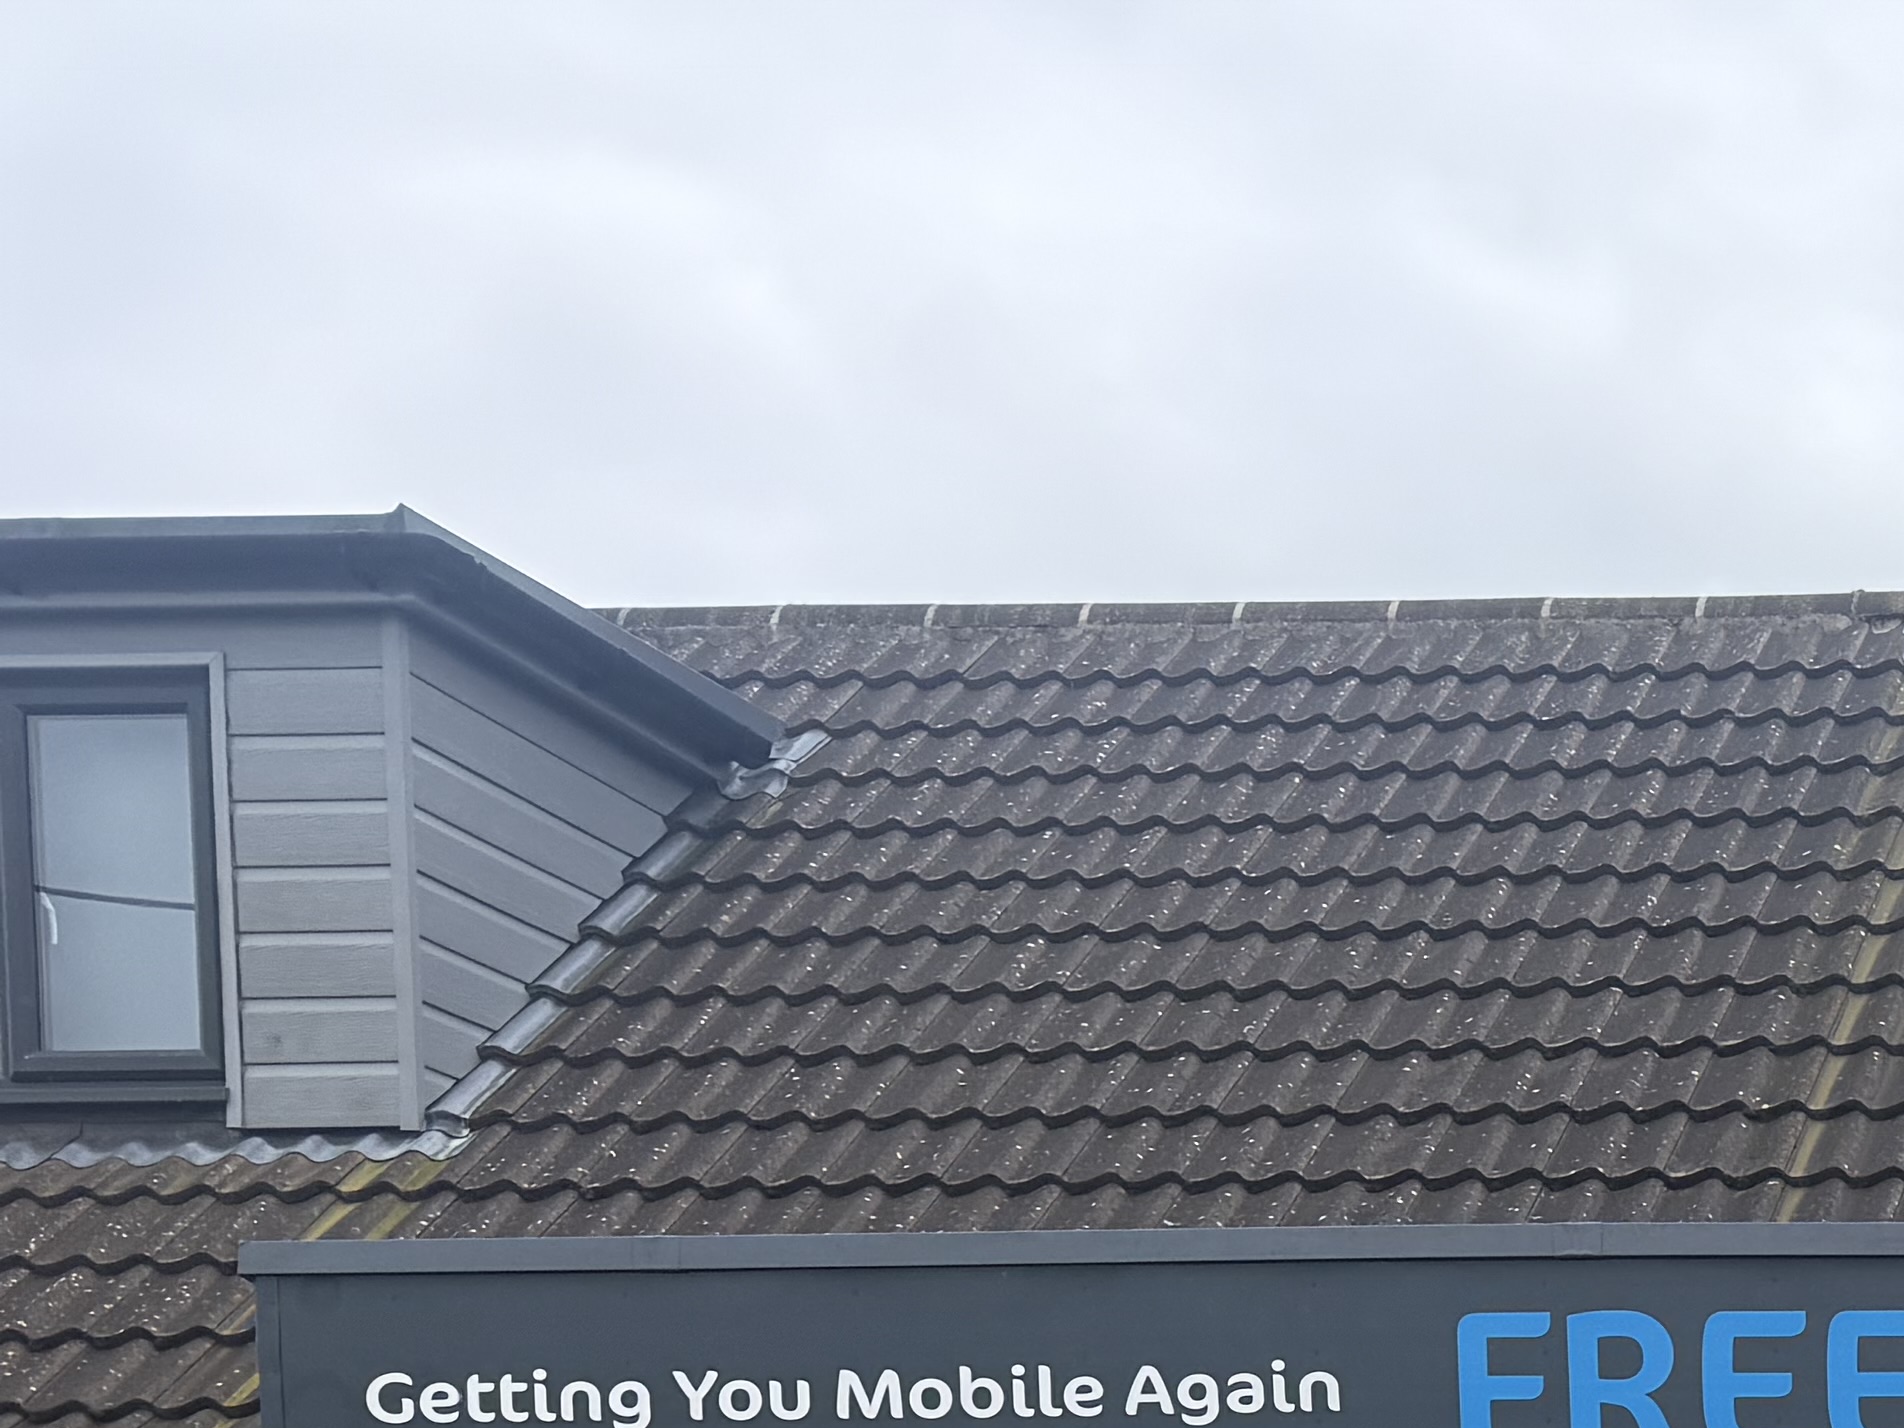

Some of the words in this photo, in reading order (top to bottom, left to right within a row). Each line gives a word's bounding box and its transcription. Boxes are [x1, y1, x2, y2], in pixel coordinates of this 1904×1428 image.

[672, 1370, 812, 1422] You
[836, 1364, 1104, 1420] Mobile
[1125, 1359, 1341, 1426] Again
